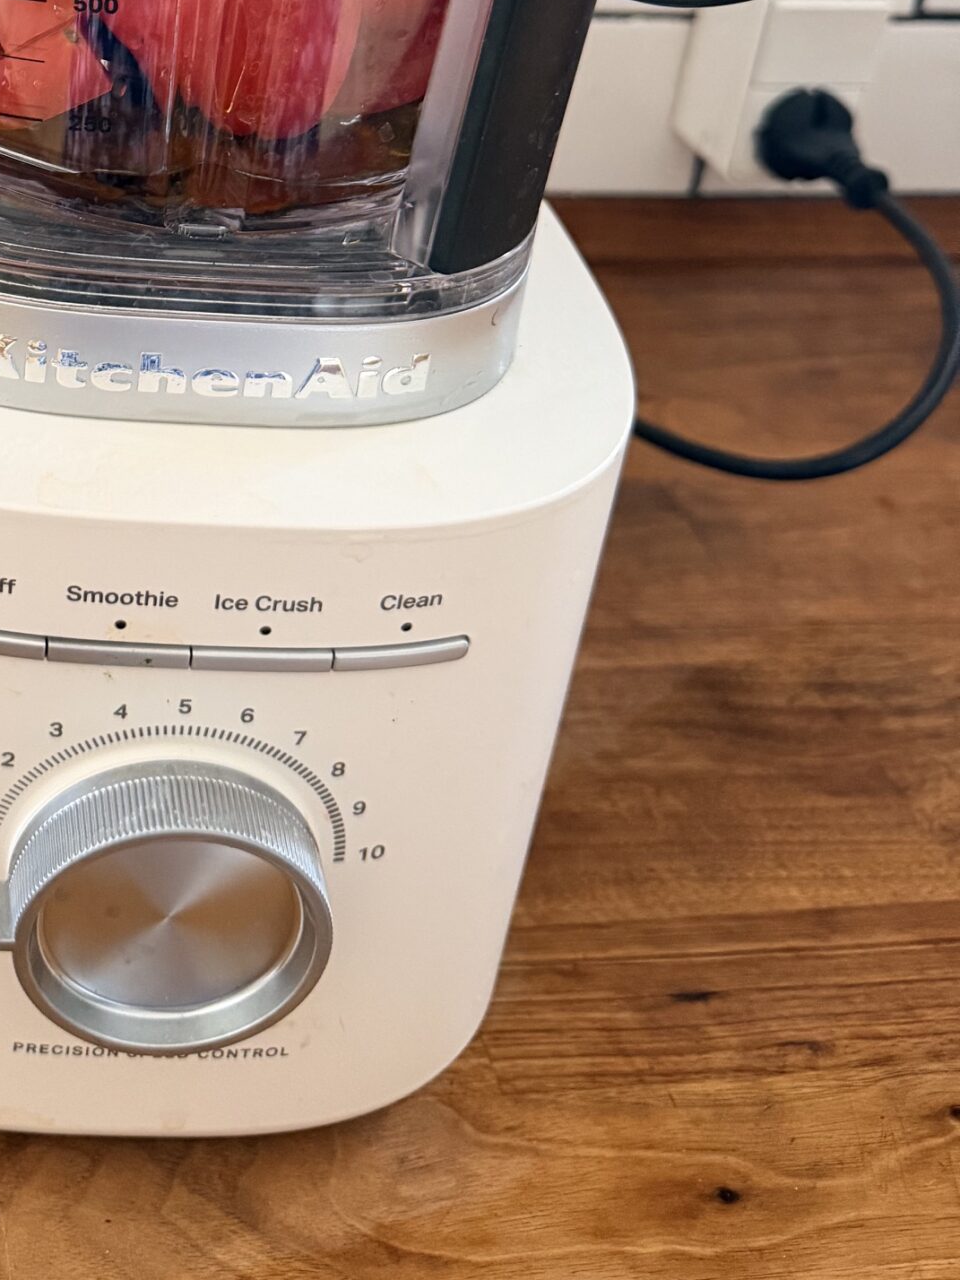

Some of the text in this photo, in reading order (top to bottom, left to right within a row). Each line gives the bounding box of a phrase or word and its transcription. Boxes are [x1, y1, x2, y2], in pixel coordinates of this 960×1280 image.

[68, 115, 111, 133] 250
[66, 585, 179, 608] Smoothie
[214, 594, 323, 612] Ice Crush
[380, 593, 443, 611] Clean
[114, 705, 128, 720] 4
[178, 699, 192, 715] 5
[240, 708, 254, 724] 6
[49, 723, 64, 738] 3
[293, 730, 307, 746] 7
[1, 752, 15, 768] 2
[332, 761, 346, 777] 8
[352, 800, 366, 816] 9
[358, 844, 385, 861] 10
[12, 1041, 119, 1058] PRECISION
[197, 1046, 289, 1059] CONTROL
